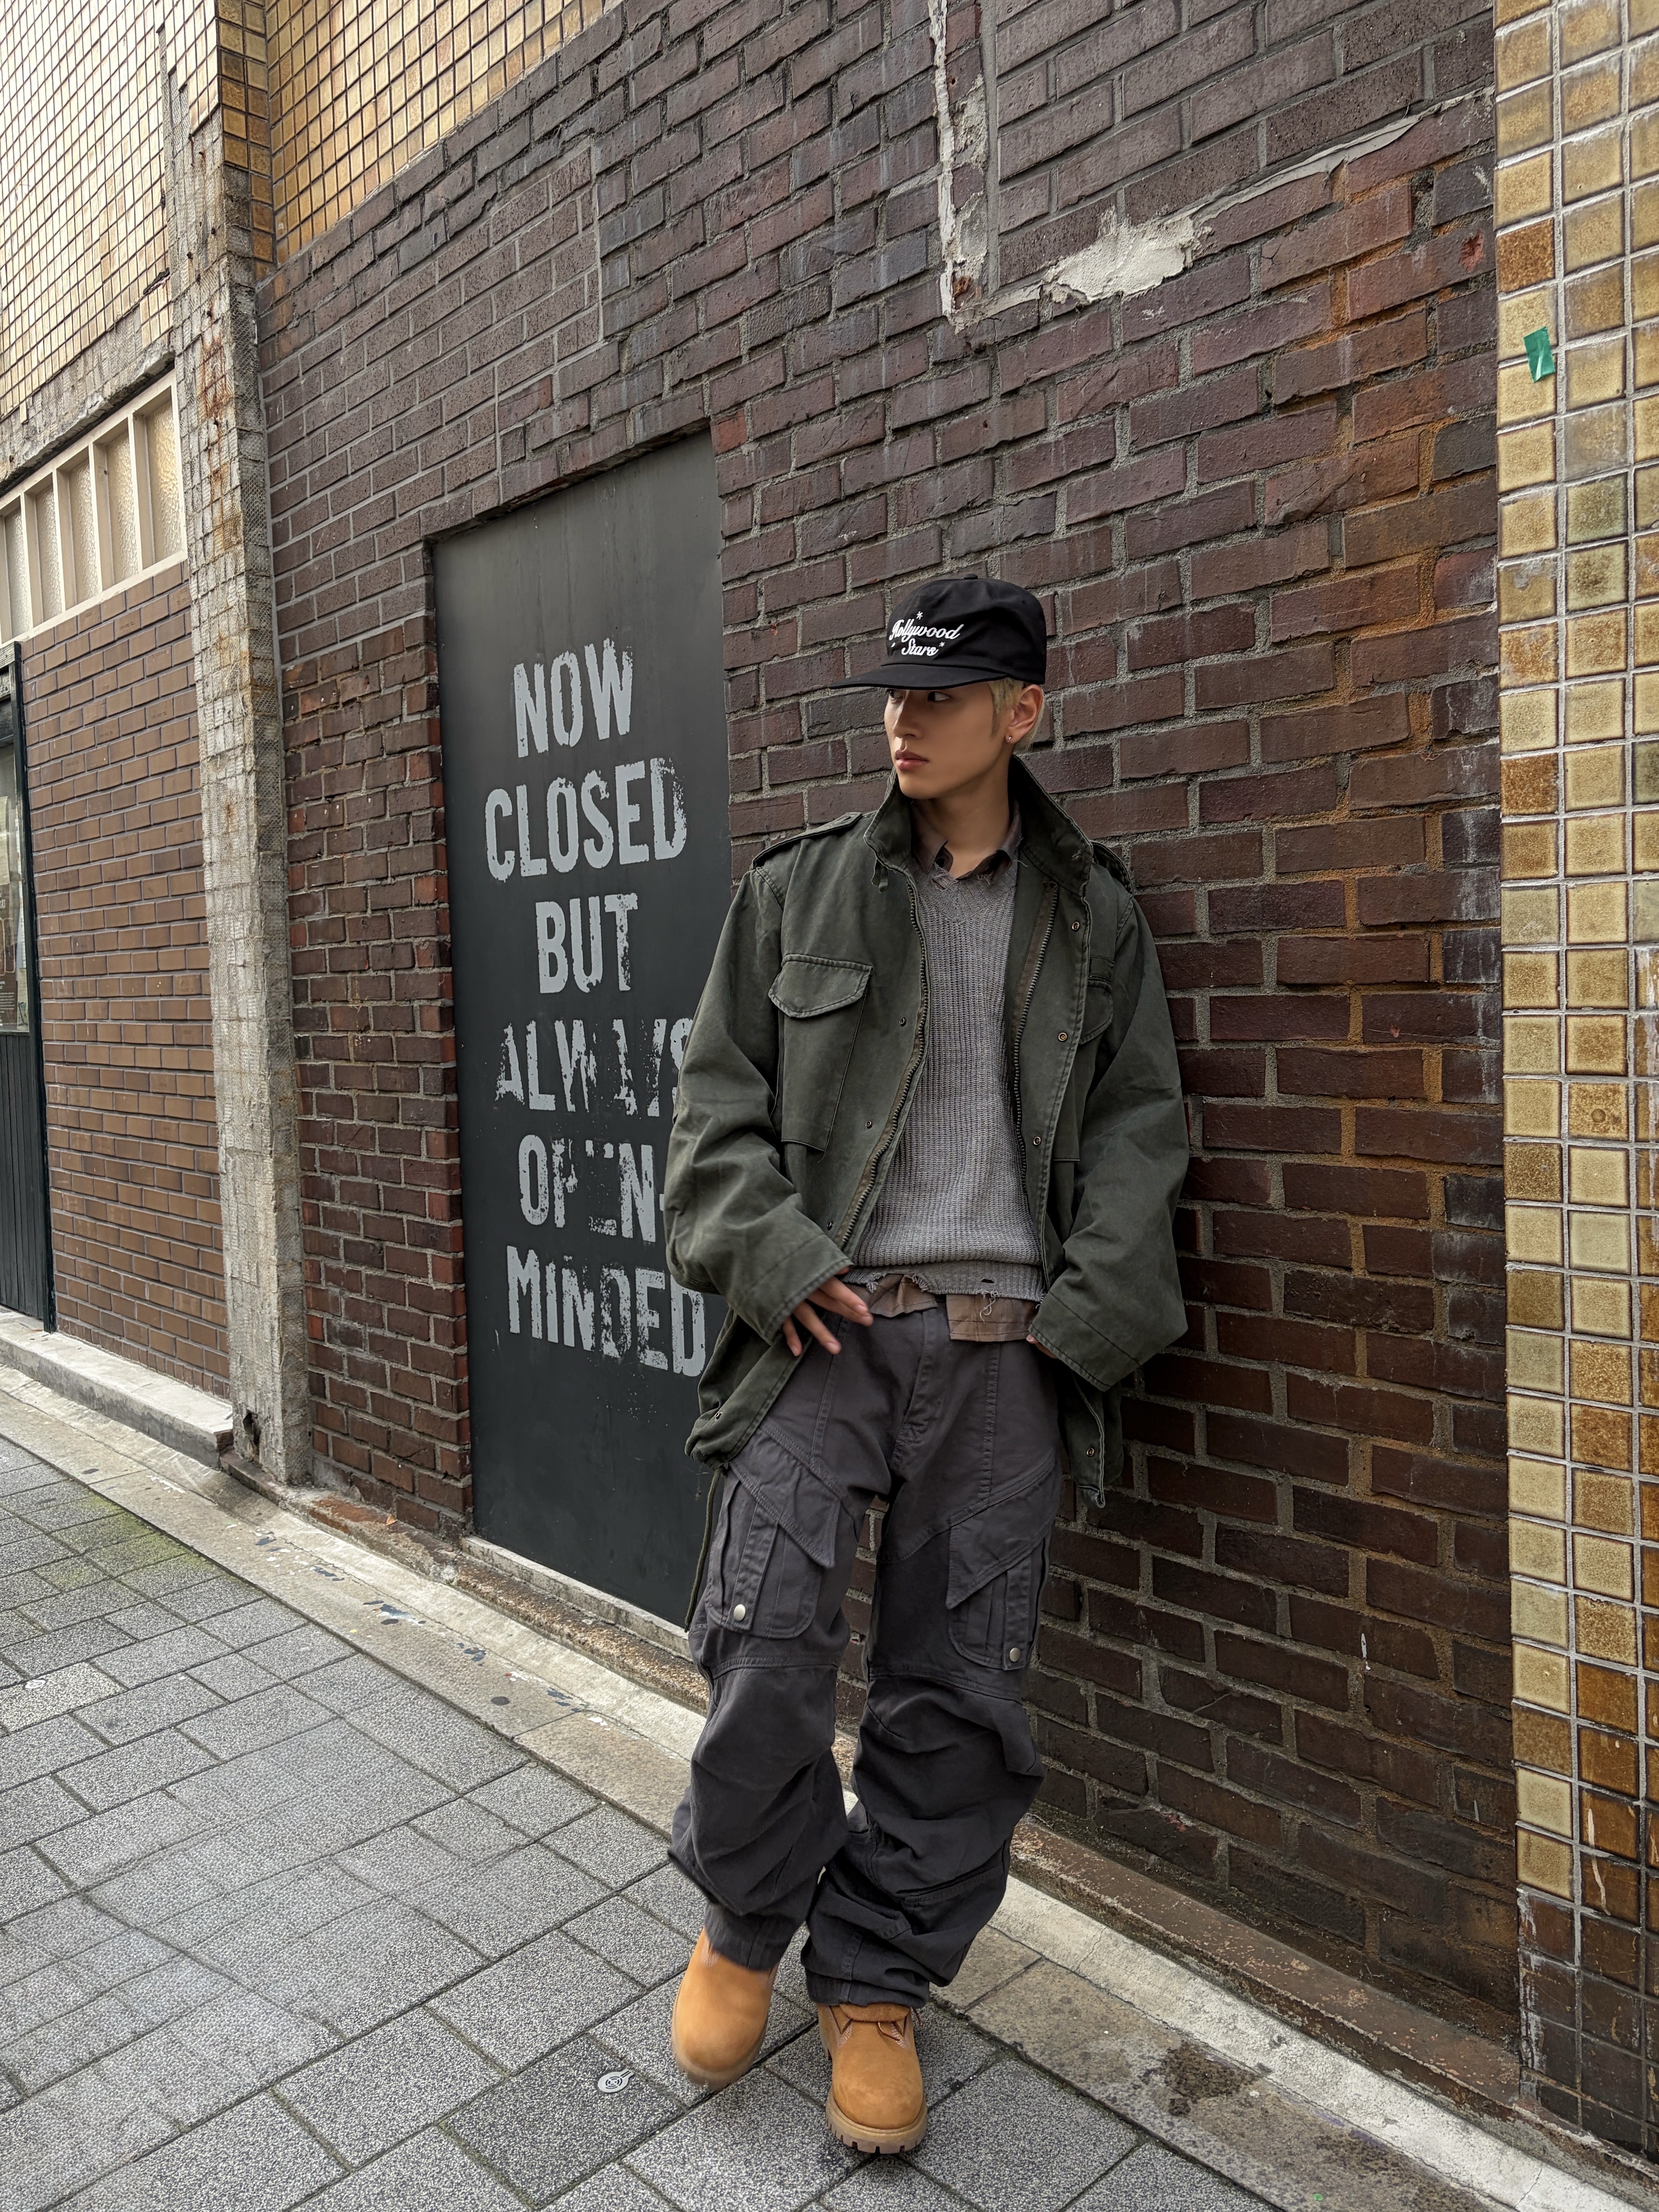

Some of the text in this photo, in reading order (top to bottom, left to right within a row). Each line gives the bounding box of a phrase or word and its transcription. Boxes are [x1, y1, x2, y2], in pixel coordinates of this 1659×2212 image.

[514, 638, 633, 758] NOW
[902, 638, 939, 656] Stars
[485, 757, 687, 883] CLOSED
[536, 892, 638, 994] BUT
[518, 1134, 665, 1242] OPN
[507, 1245, 706, 1377] MINDED
